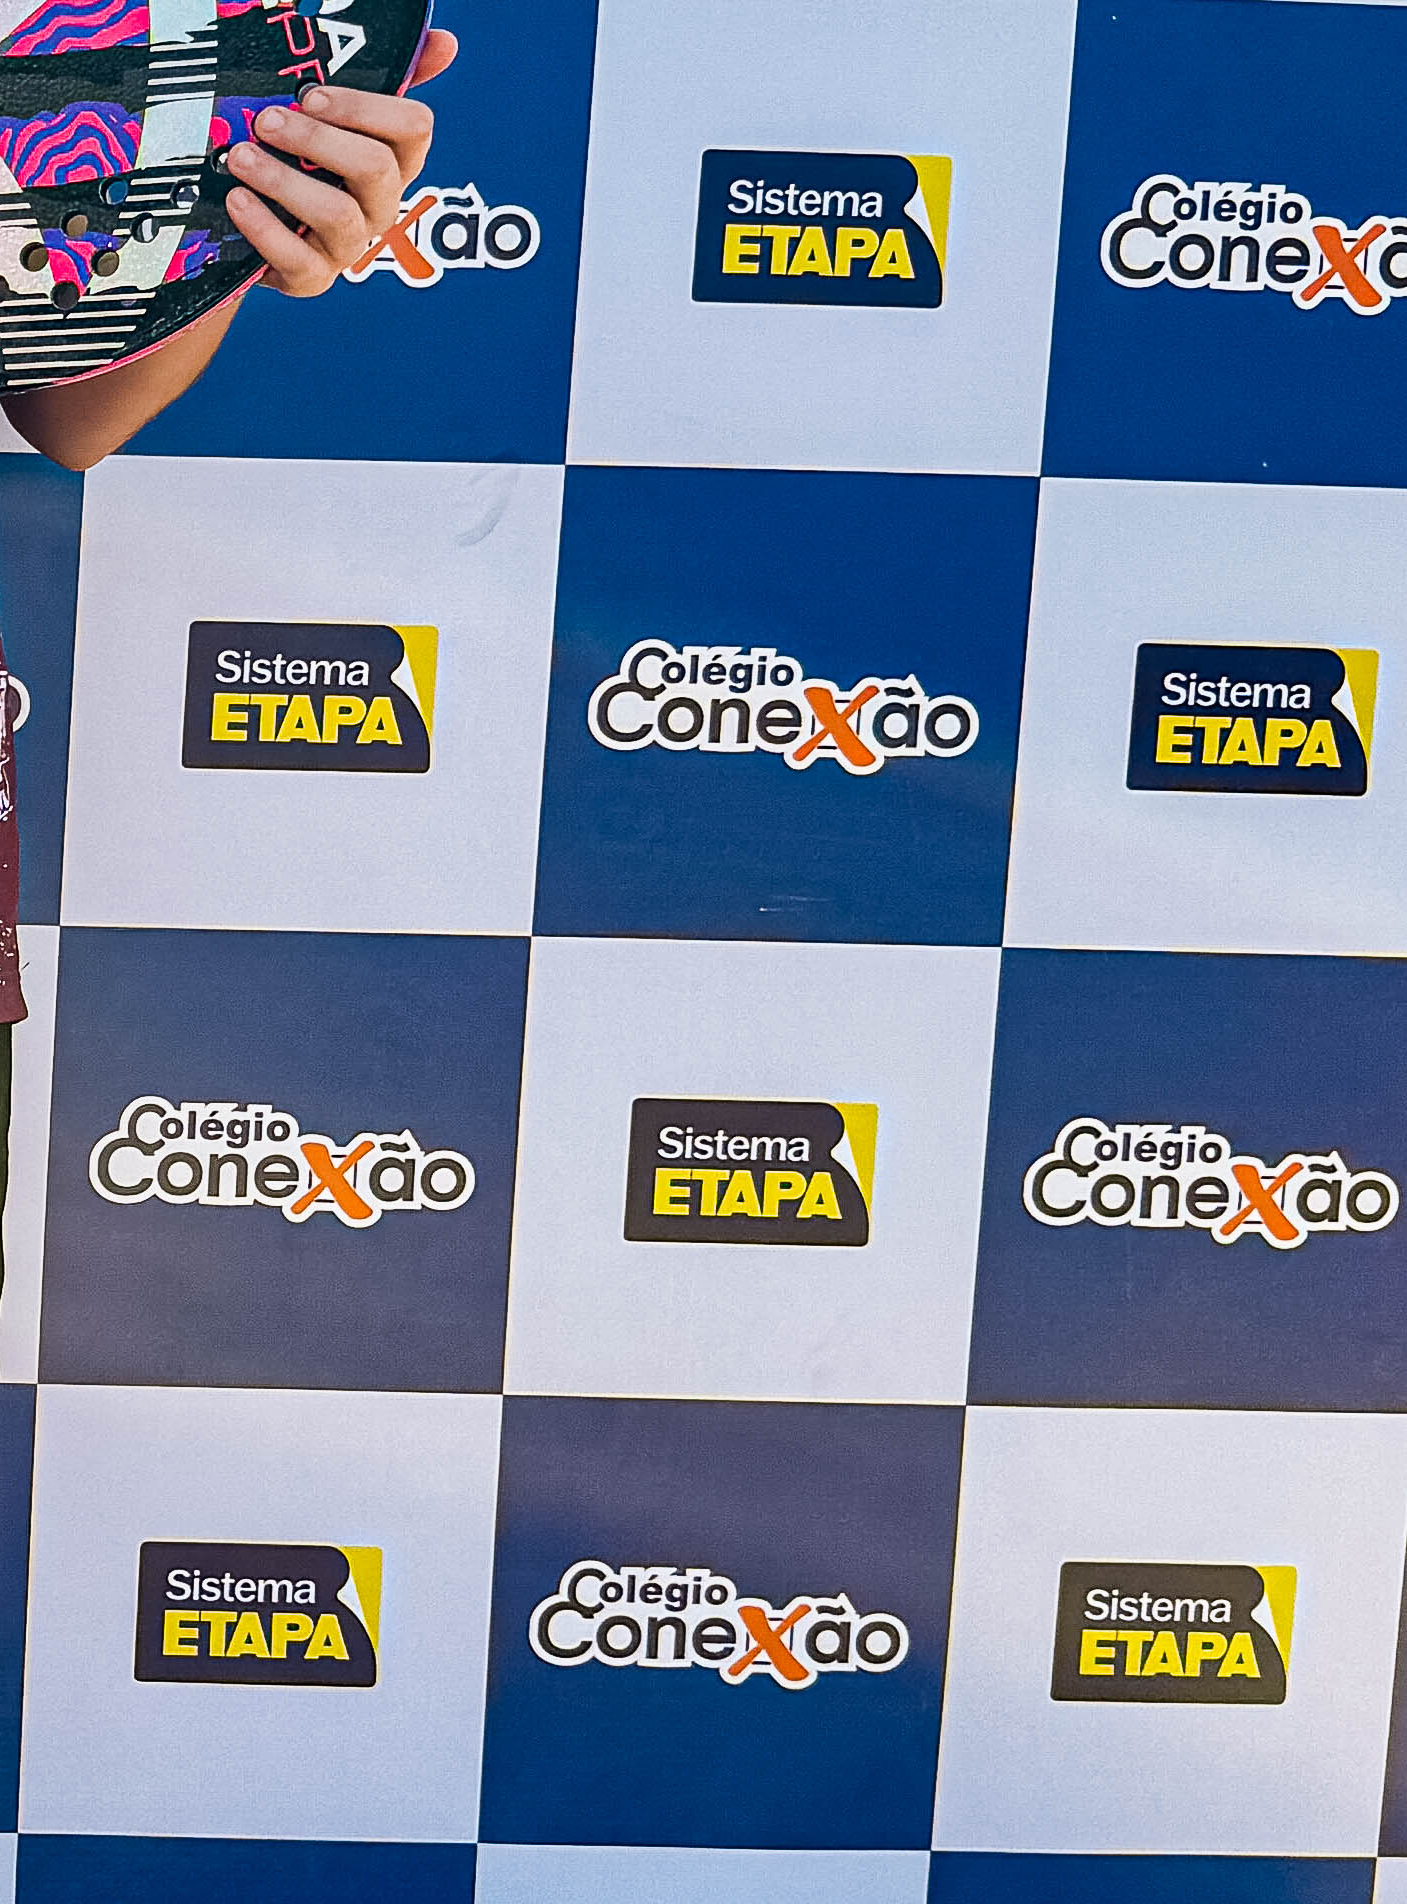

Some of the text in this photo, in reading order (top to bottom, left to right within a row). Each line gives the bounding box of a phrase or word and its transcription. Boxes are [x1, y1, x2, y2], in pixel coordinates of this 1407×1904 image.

[728, 180, 883, 219] Sistema
[1140, 180, 1305, 233] Colégio
[722, 226, 915, 278] ETAPA
[216, 650, 369, 688] Sistema
[626, 646, 796, 696] Colégio
[1163, 674, 1310, 709] Sistema
[209, 696, 403, 746] ETAPA
[1155, 719, 1343, 768] ETAPA
[129, 1099, 291, 1152] Colégio
[658, 1126, 809, 1164] Sistema
[1063, 1120, 1223, 1170] Colégio
[652, 1170, 842, 1219] ETAPA
[167, 1569, 316, 1604] Sistema
[568, 1565, 728, 1610] Colégio
[1085, 1589, 1232, 1624] Sistema
[162, 1610, 349, 1659] ETAPA
[1077, 1630, 1259, 1677] ETAPA
